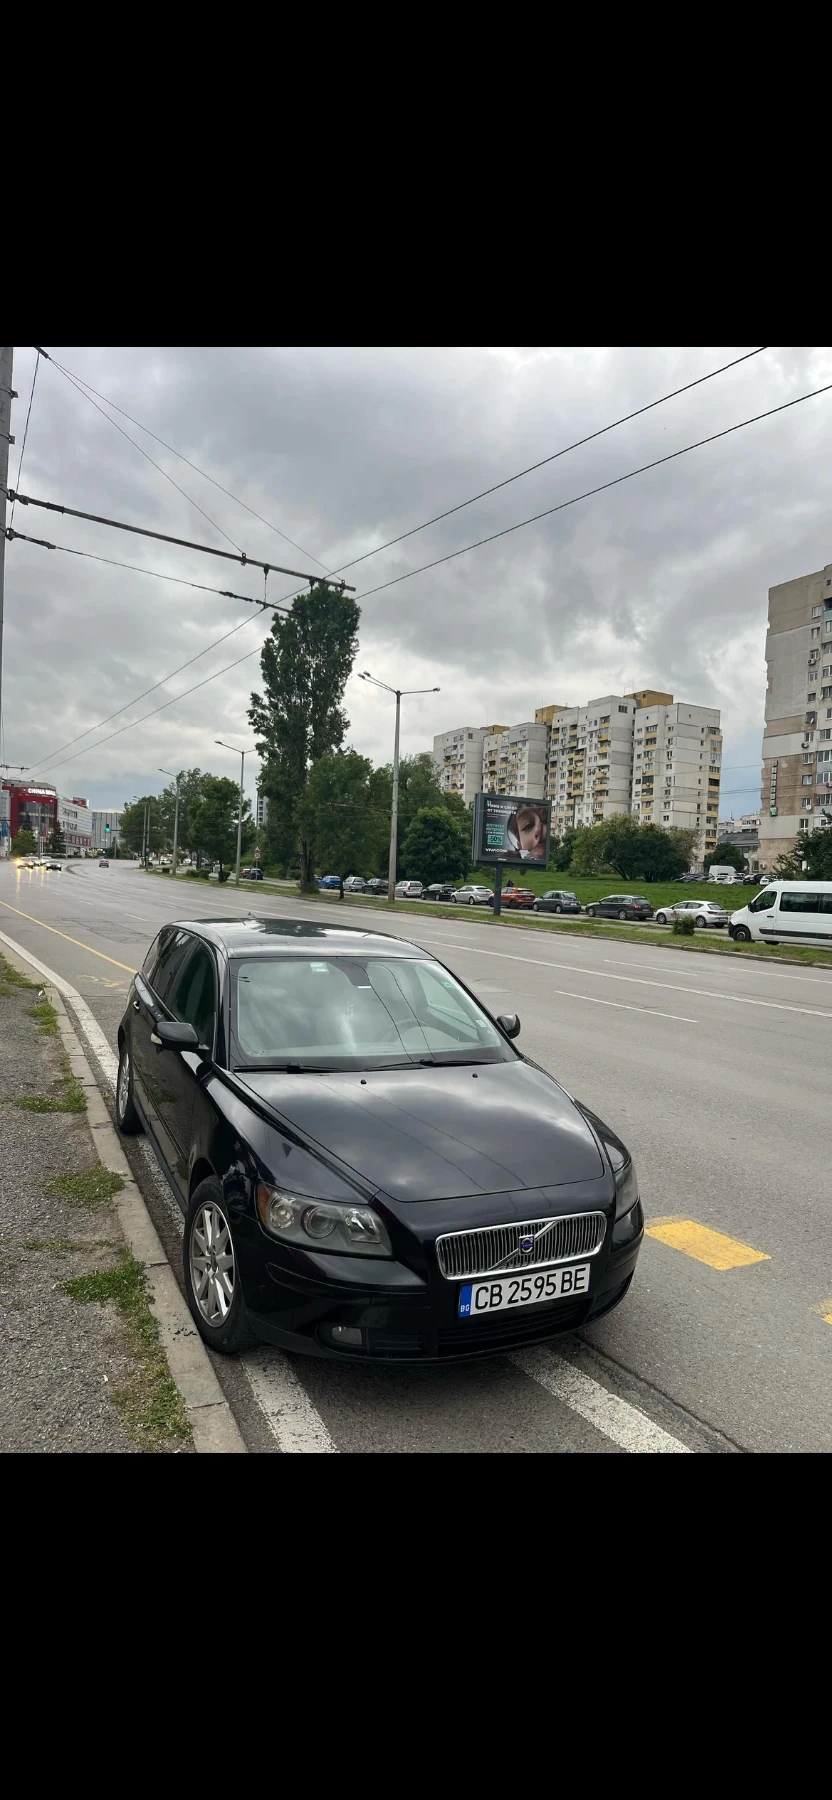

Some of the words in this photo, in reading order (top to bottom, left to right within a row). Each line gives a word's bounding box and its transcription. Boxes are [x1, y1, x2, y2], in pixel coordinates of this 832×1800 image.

[474, 1283, 503, 1310] CB
[507, 1273, 557, 1305] 2595
[560, 1267, 587, 1294] BE
[460, 1304, 470, 1312] BG
